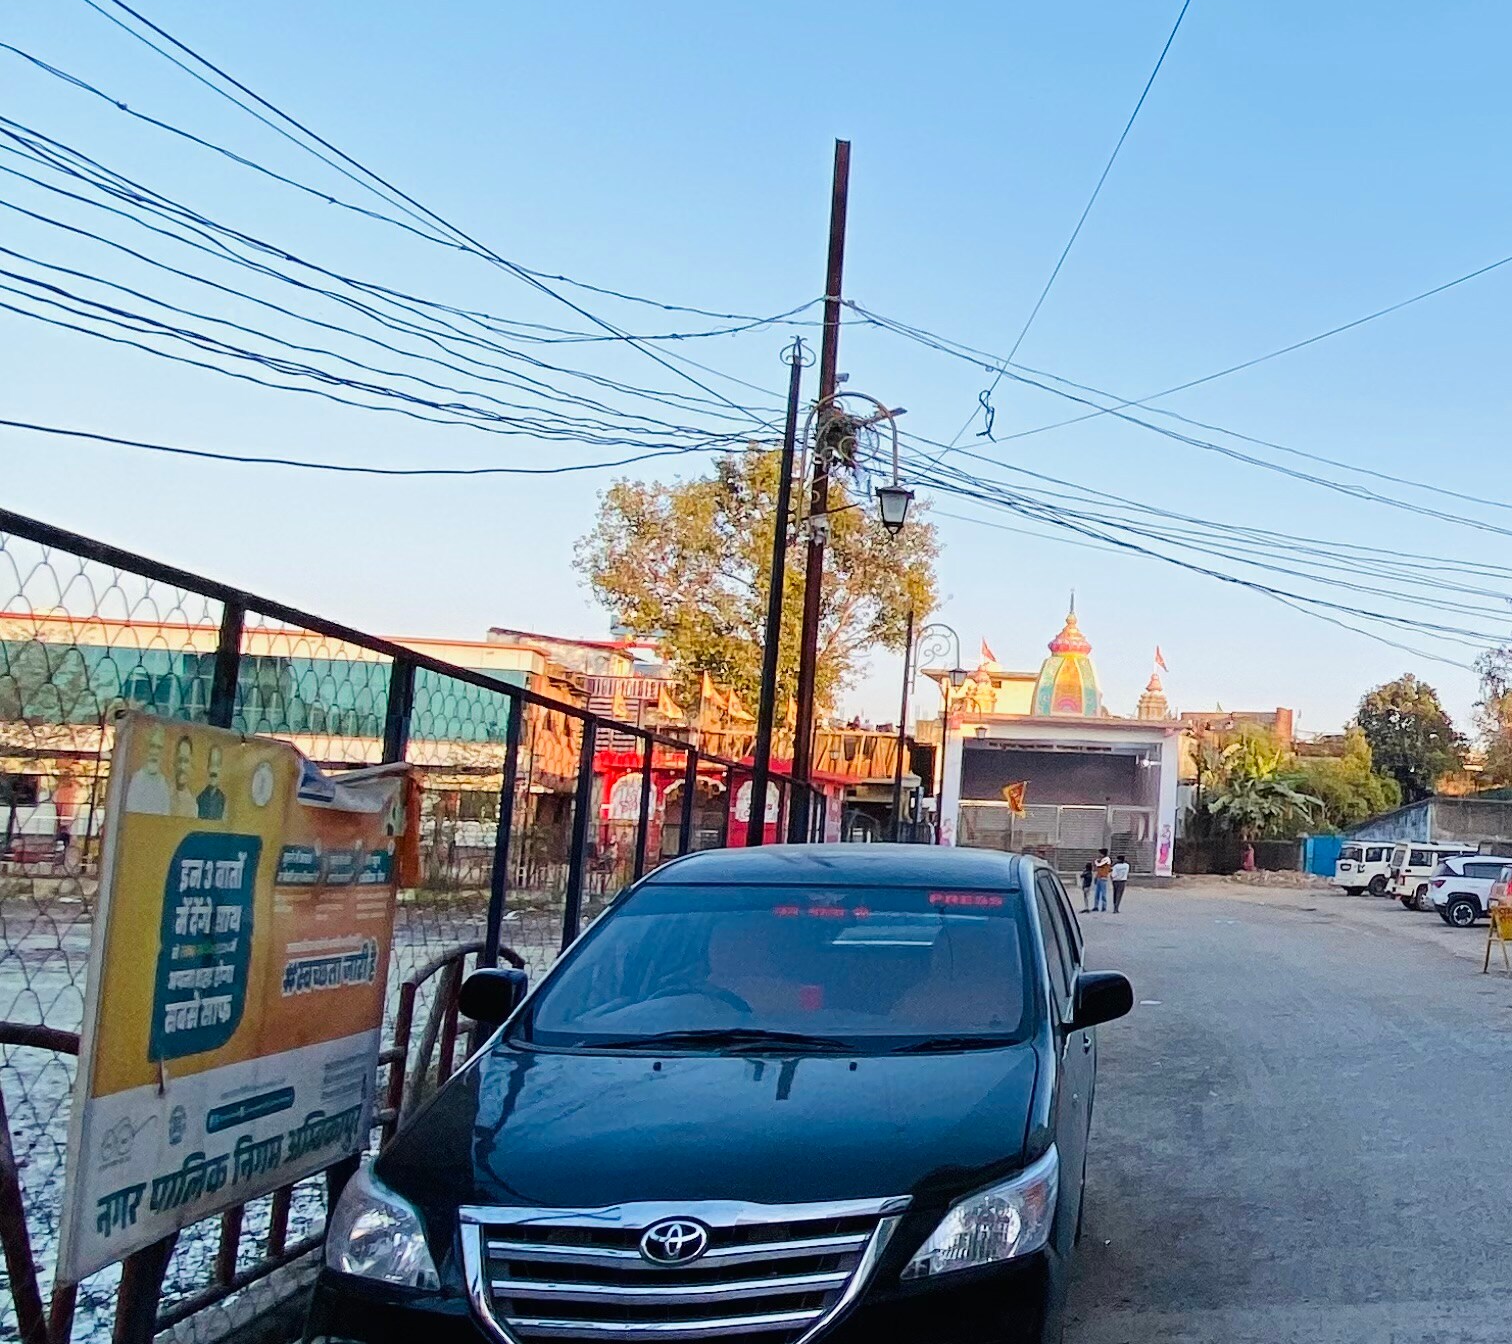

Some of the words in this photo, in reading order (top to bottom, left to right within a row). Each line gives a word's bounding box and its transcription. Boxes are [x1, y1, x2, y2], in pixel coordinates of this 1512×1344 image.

[928, 892, 1003, 906] PRESS
[97, 1182, 147, 1238] नगर
[150, 1151, 230, 1214] पालिक
[233, 1135, 285, 1186] निगम
